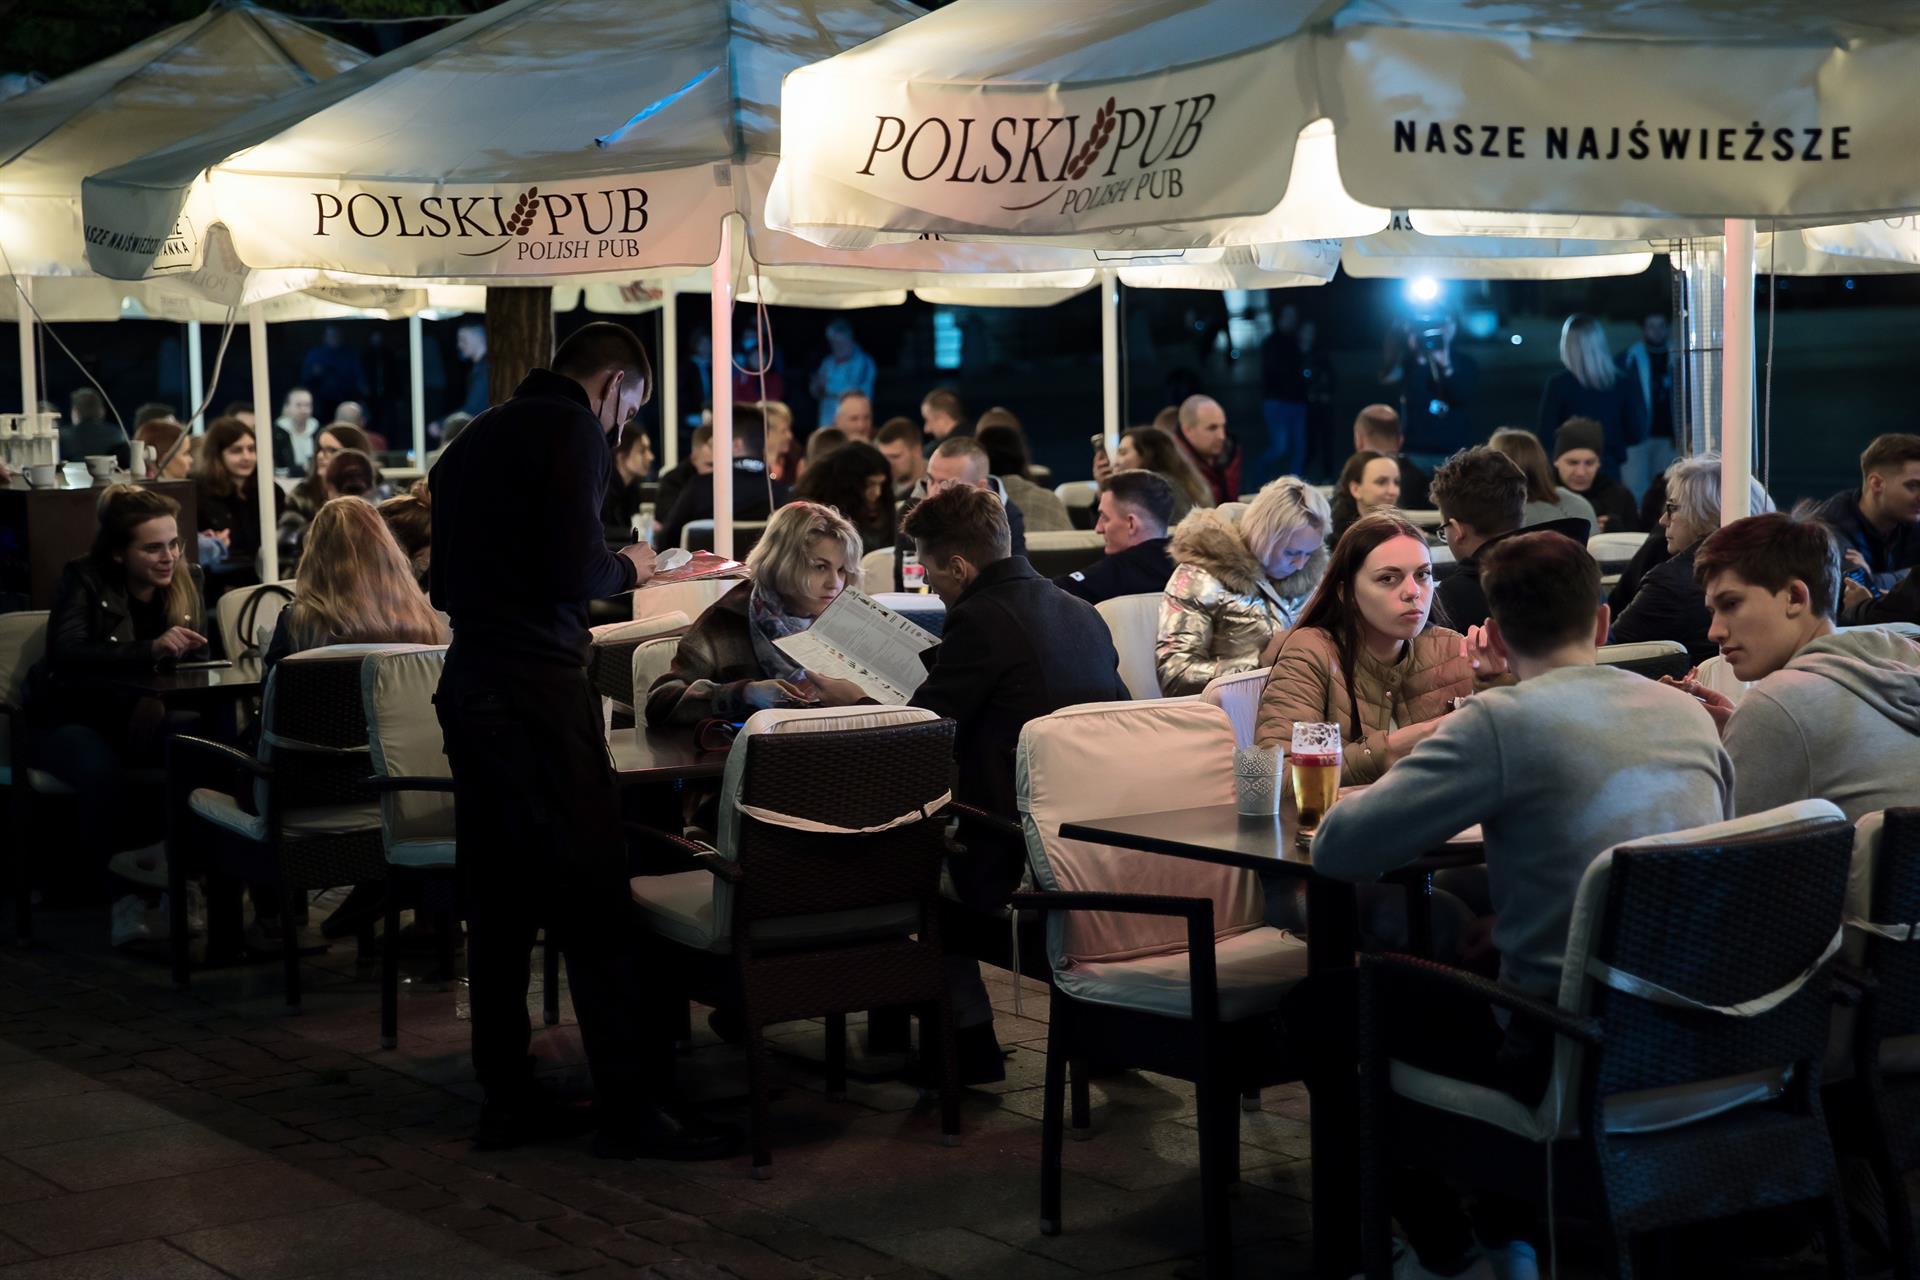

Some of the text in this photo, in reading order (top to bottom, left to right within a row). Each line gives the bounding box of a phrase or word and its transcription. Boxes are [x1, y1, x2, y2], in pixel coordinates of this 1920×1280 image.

[856, 93, 1215, 184] POLSKI PUB
[1394, 120, 1851, 161] NASZE NAJŚWIEŻSZE
[310, 187, 649, 237] POLSKI PUB
[1060, 168, 1184, 214] POLISH PUB
[518, 238, 640, 260] POLISH PUB
